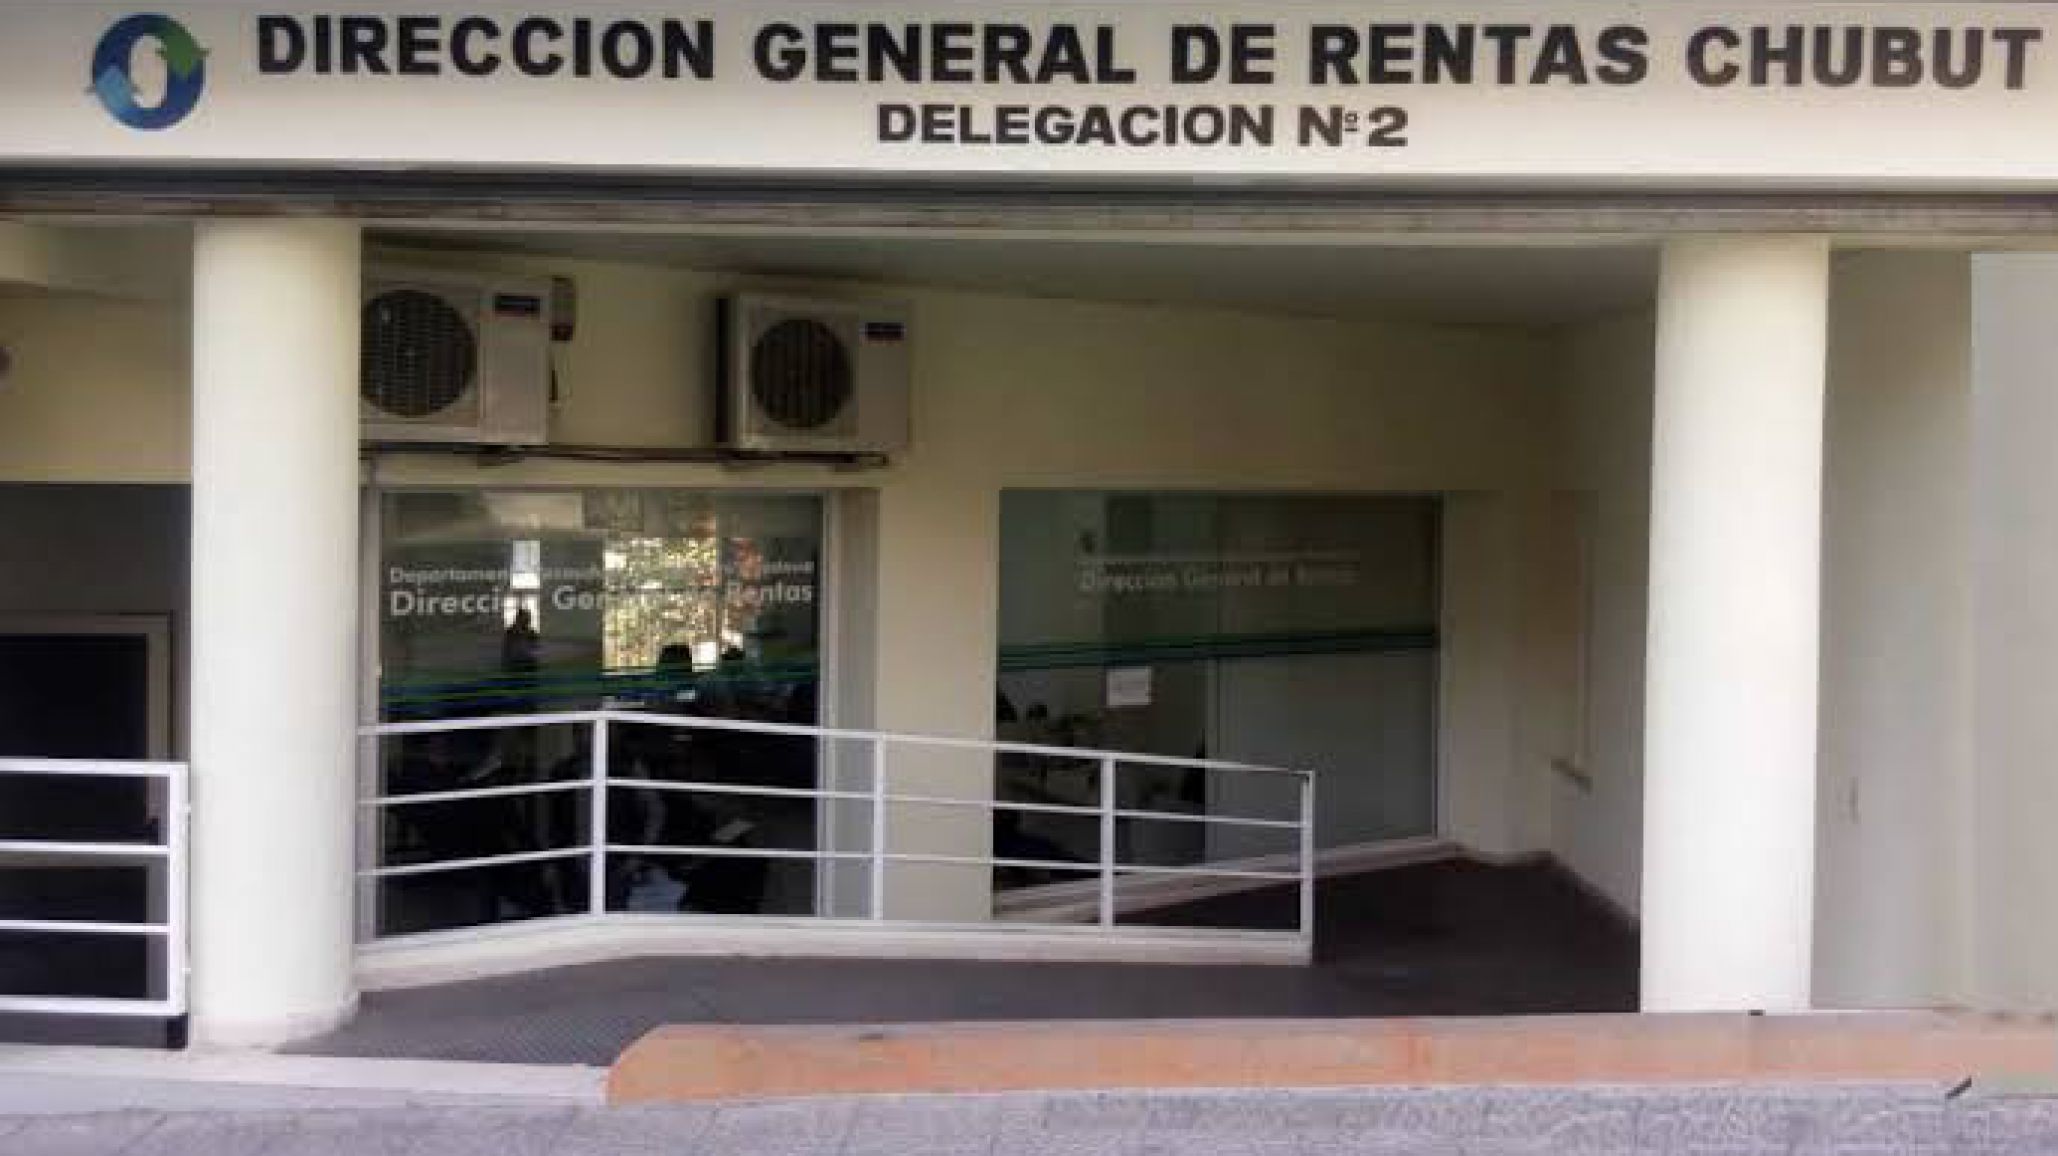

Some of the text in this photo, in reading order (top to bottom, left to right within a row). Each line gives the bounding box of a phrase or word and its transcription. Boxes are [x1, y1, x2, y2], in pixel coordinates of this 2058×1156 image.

[256, 14, 2041, 88] DIRECCION GENERAL DE RENTAS CHUBUT
[877, 103, 1274, 146] DELEGACION
[390, 584, 538, 616] Direcci
